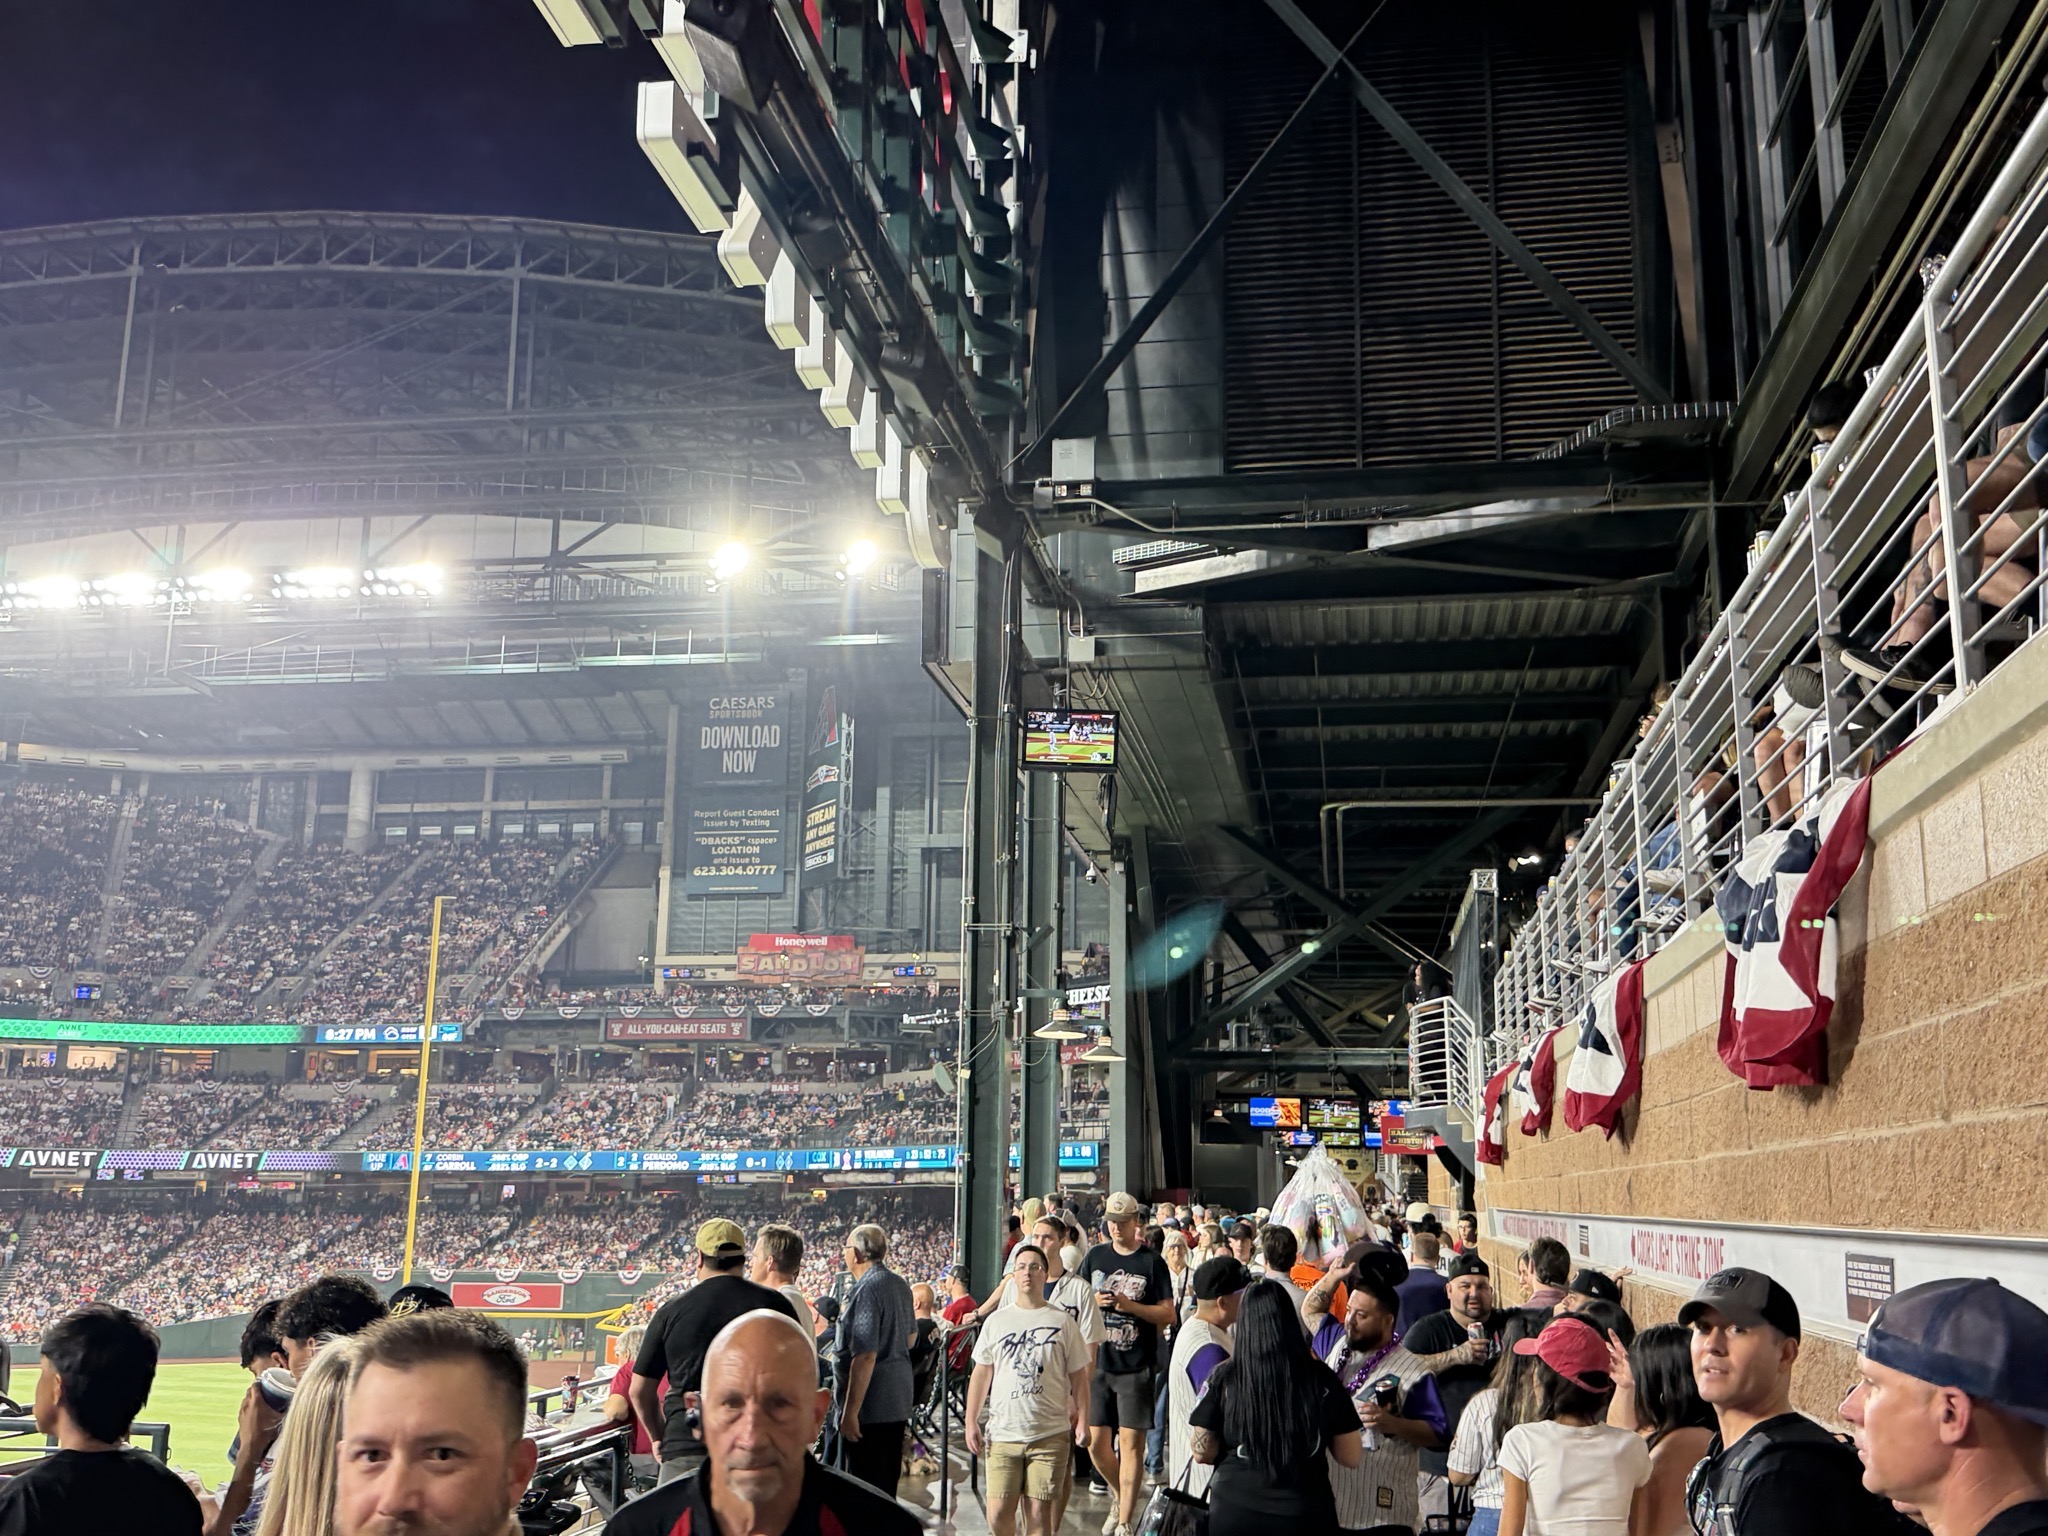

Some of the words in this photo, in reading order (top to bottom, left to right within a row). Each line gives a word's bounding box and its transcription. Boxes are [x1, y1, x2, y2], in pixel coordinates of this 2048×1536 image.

[709, 696, 775, 710] CAESARS
[709, 709, 763, 719] SPORTSBOOK
[701, 725, 780, 749] DOWNLOAD
[723, 750, 757, 773] NOW
[694, 810, 720, 818] Report
[723, 809, 745, 817] Guest
[747, 809, 779, 817] Conduct
[806, 805, 836, 828] STREAM
[730, 819, 739, 828] by
[742, 819, 770, 827] Texting
[805, 828, 817, 841] ANY
[818, 821, 835, 837] GAME
[711, 846, 760, 854] LOCATION
[805, 835, 835, 854] ANYWHERE
[752, 856, 760, 864] to
[693, 865, 777, 876] 623.304.0777
[775, 936, 828, 948] Honeywell
[1066, 985, 1111, 1005] HEESE
[58, 1023, 88, 1031] AVNET
[627, 1023, 699, 1034] ALL-YOU-CAN-EAT
[700, 1023, 726, 1034] SEATS
[325, 1028, 354, 1040] 8:27
[355, 1027, 376, 1040] PM
[771, 1084, 799, 1092] BAR-S
[19, 1150, 98, 1167] AVNET
[192, 1152, 258, 1169] AVNET
[368, 1153, 387, 1162] DUE
[370, 1162, 383, 1170] UP
[435, 1161, 476, 1170] CARROLL
[642, 1161, 689, 1170] PERDOMO
[1676, 1233, 1701, 1280] STRIKE
[496, 1294, 516, 1303] Ford
